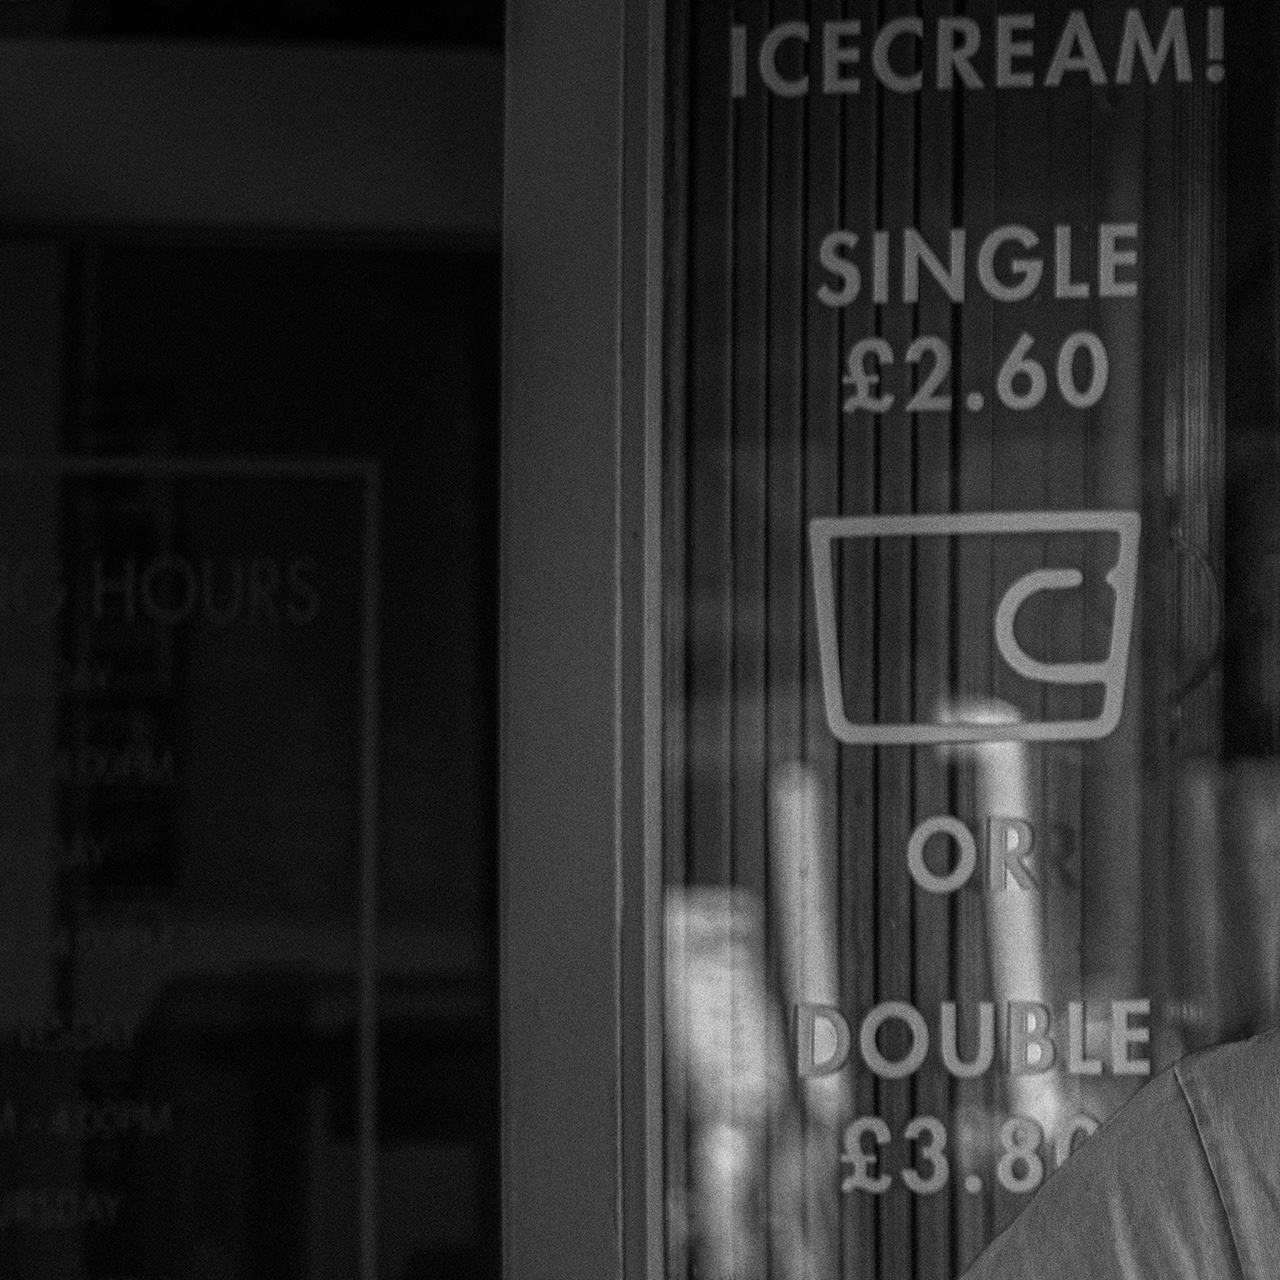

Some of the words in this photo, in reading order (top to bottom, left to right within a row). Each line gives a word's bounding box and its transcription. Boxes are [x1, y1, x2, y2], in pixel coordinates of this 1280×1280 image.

[730, 6, 1226, 99] ICECREAM!
[816, 222, 1139, 307] SINGLE
[841, 331, 1110, 413] £2.60
[92, 552, 321, 625] HOURS
[907, 815, 1035, 892] OR
[797, 999, 1151, 1078] DOUBLE
